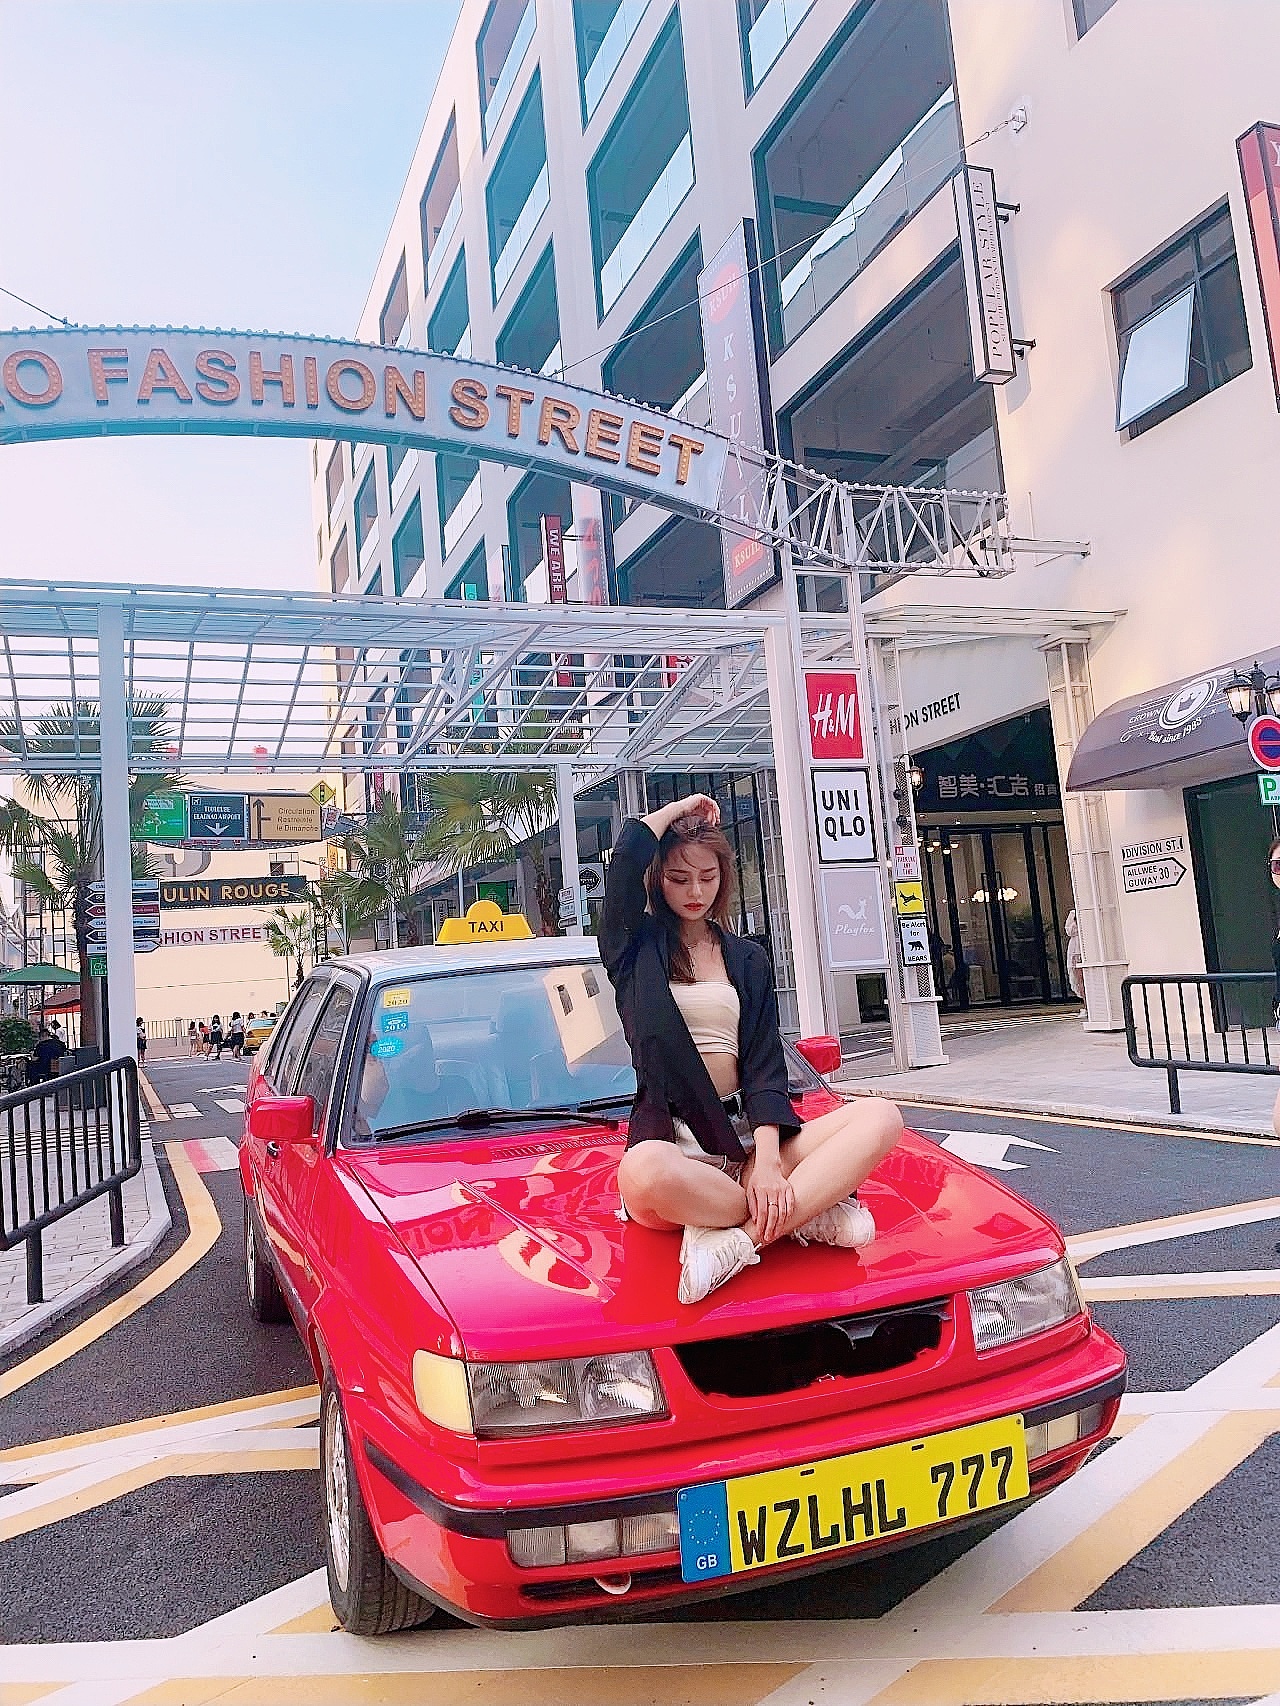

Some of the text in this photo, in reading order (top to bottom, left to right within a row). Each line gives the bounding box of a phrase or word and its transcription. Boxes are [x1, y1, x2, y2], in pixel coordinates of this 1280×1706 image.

[87, 348, 425, 421] FASHION
[448, 378, 704, 485] STREET
[811, 692, 856, 739] H&M
[921, 692, 961, 723] STREET
[821, 789, 860, 811] UNI
[823, 815, 866, 841] QLO
[1125, 839, 1180, 858] DIVISION ST.
[221, 882, 289, 900] ROUGE
[1128, 875, 1158, 888] GUWAY
[468, 920, 504, 933] TAXI
[386, 999, 408, 1007] 2020
[384, 1022, 407, 1033] 2019
[738, 1445, 1013, 1566] WZLHL 777
[696, 1554, 718, 1571] GB
